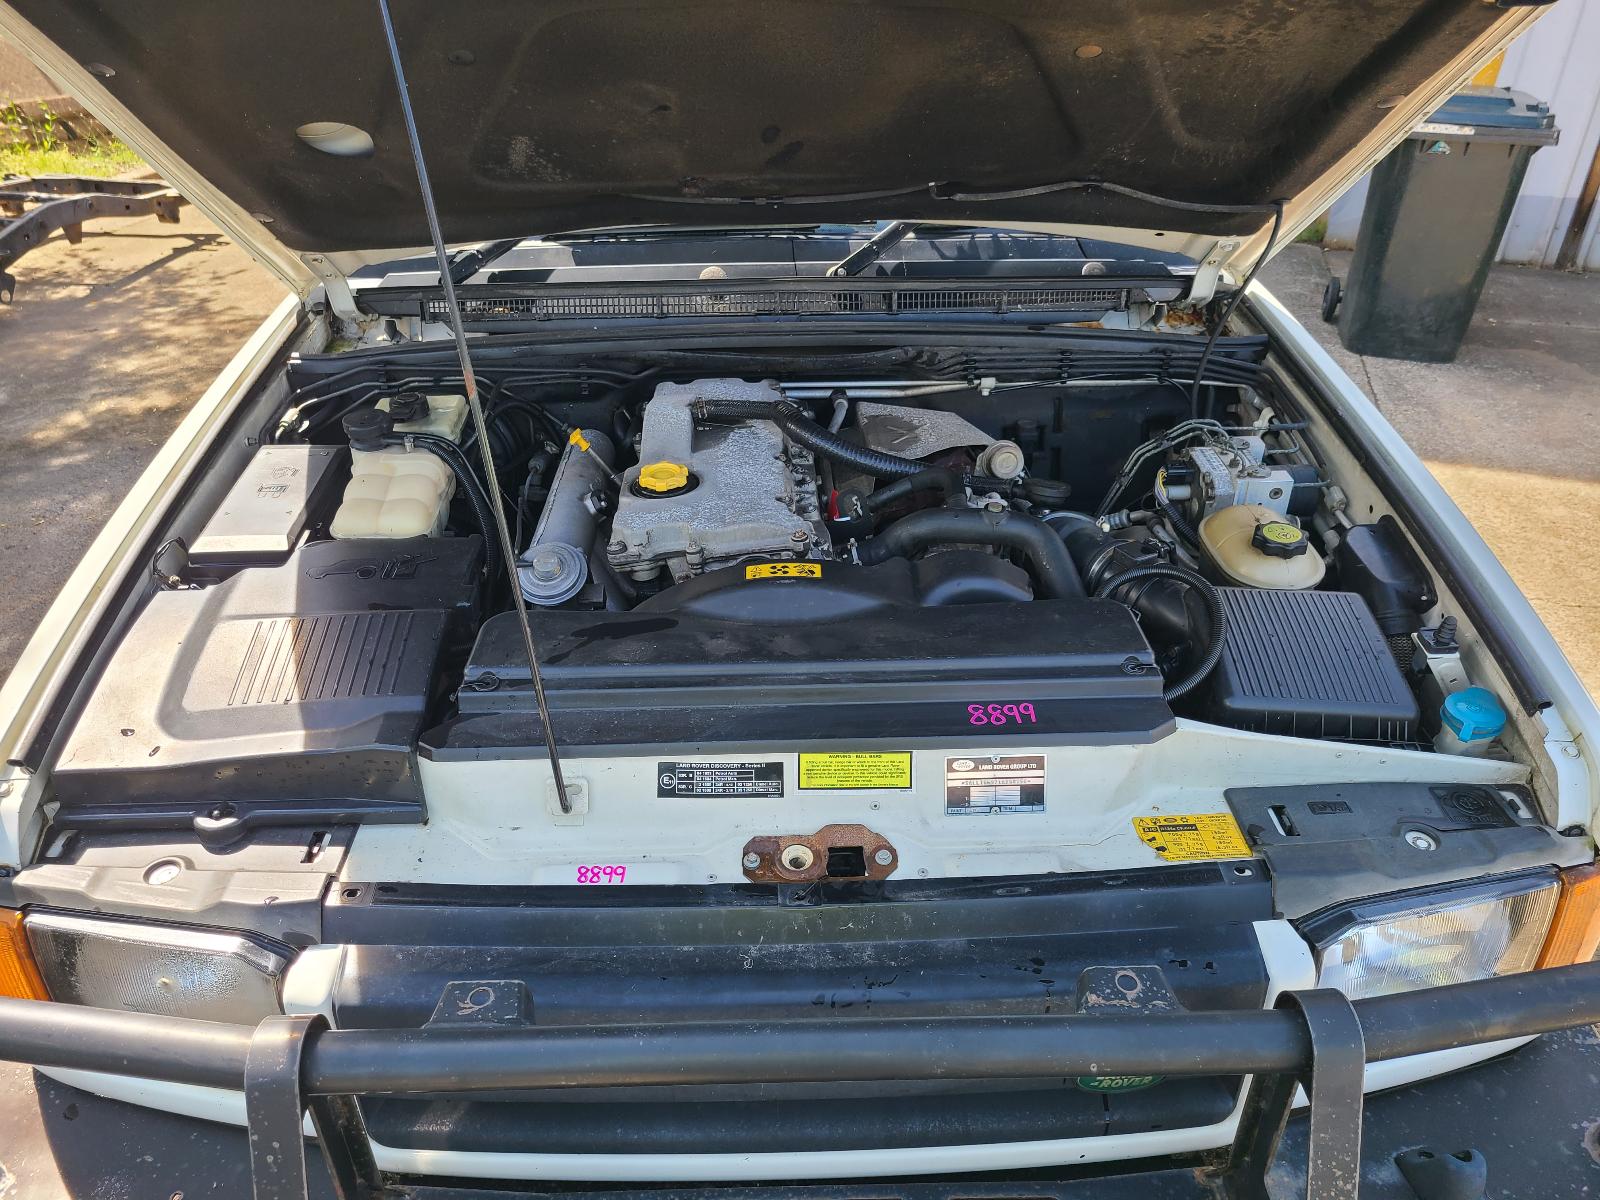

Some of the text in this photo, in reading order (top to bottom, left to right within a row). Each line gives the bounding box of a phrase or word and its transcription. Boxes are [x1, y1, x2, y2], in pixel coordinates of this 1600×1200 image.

[967, 703, 1036, 725] 8899
[577, 865, 626, 883] 8899
[1098, 1076, 1152, 1087] ROVER
